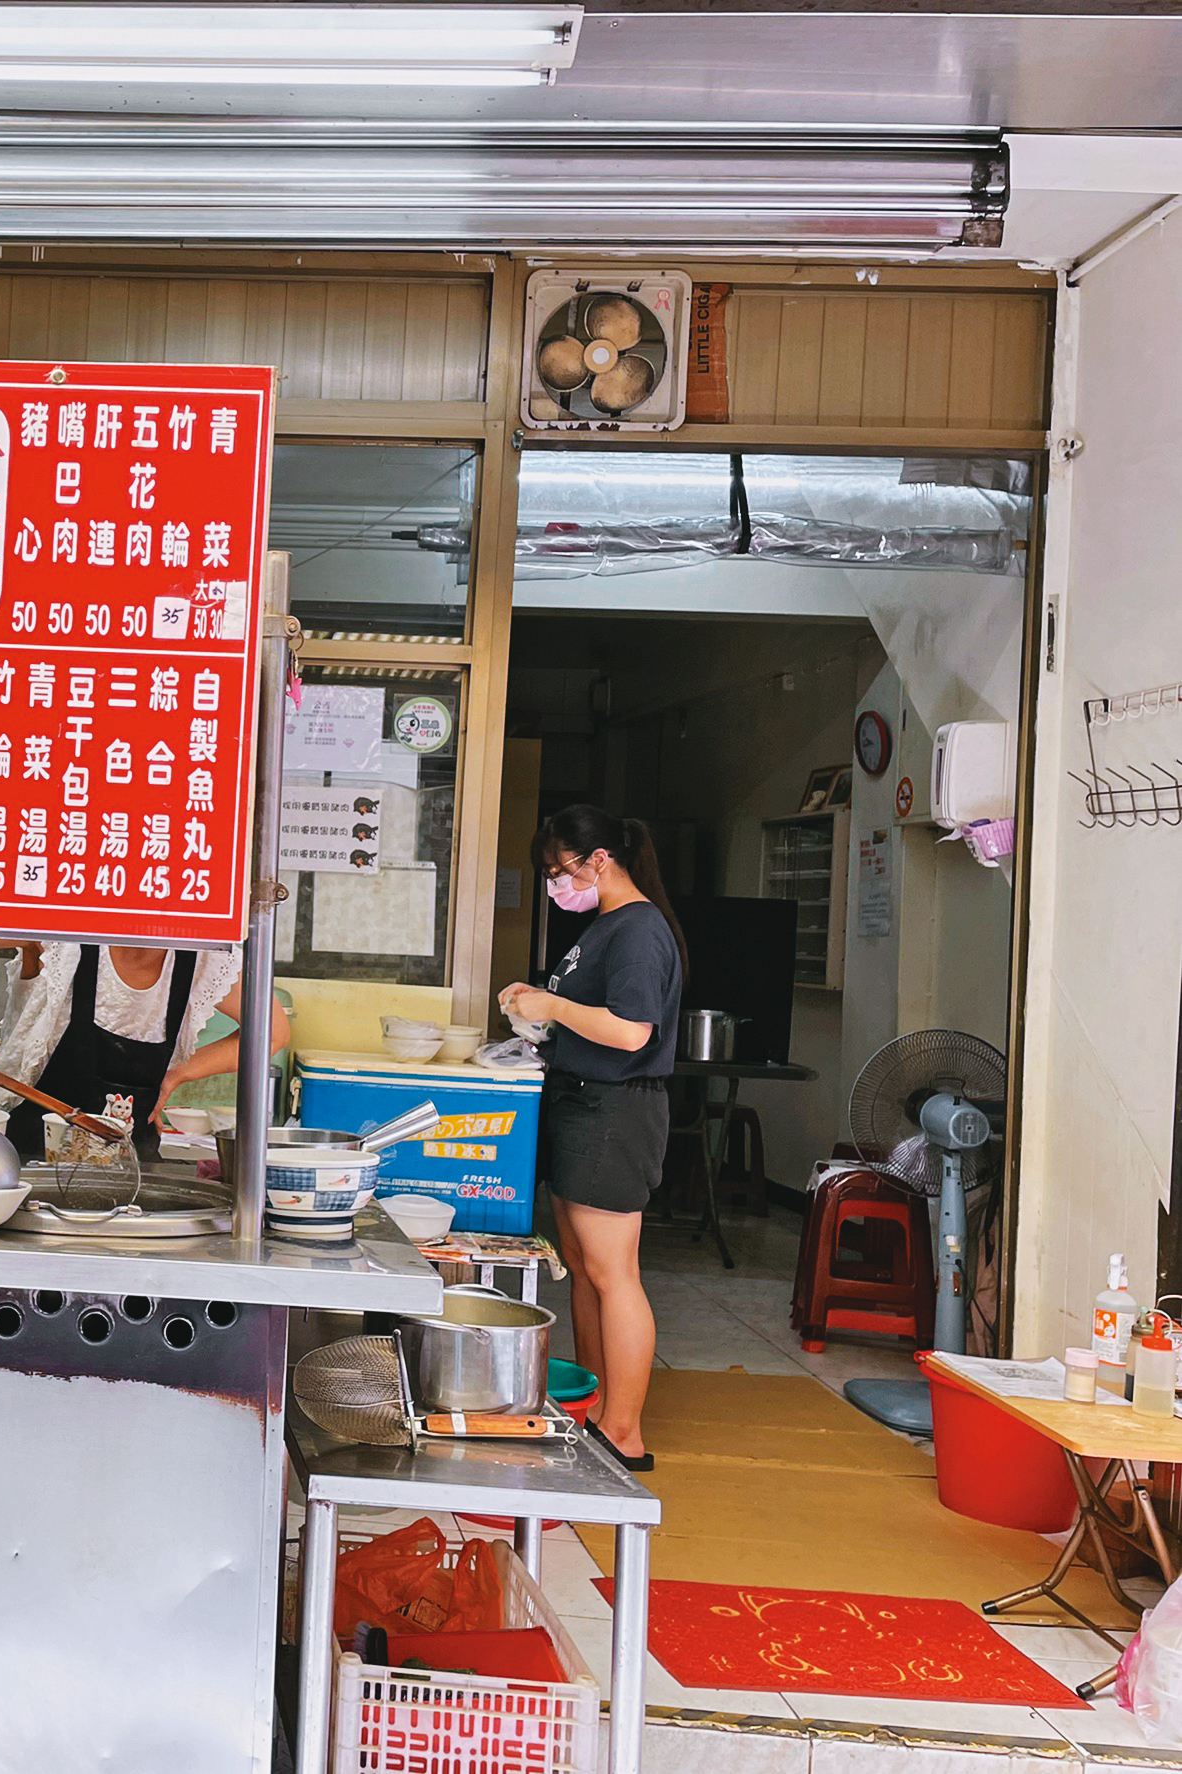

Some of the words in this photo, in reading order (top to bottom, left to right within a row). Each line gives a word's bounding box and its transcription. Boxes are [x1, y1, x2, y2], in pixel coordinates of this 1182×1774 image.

[698, 324, 710, 374] LITTLE
[14, 402, 49, 562] 豬心
[52, 402, 86, 563] 嘴巴肉
[88, 404, 123, 566] 肝連
[125, 406, 160, 567] 五花肉
[161, 405, 196, 568] 竹輪
[202, 407, 237, 569] 青菜
[12, 601, 37, 632] 50
[48, 603, 73, 634] 50
[85, 605, 110, 635] 50
[122, 606, 147, 637] 50
[161, 607, 183, 624] 35
[194, 609, 207, 639] 50
[209, 609, 223, 639] 30
[195, 578, 208, 601] 大
[19, 662, 56, 854] 青菜湯
[58, 668, 96, 856] 豆干包湯
[100, 668, 137, 858] 三色湯
[141, 666, 179, 860] 綜合湯
[183, 668, 219, 861] 自製魚丸
[22, 864, 44, 882] 35
[57, 862, 86, 894] 25
[95, 864, 126, 896] 40
[139, 866, 169, 899] 45
[181, 870, 209, 901] 25
[462, 1175, 502, 1184] FRESH
